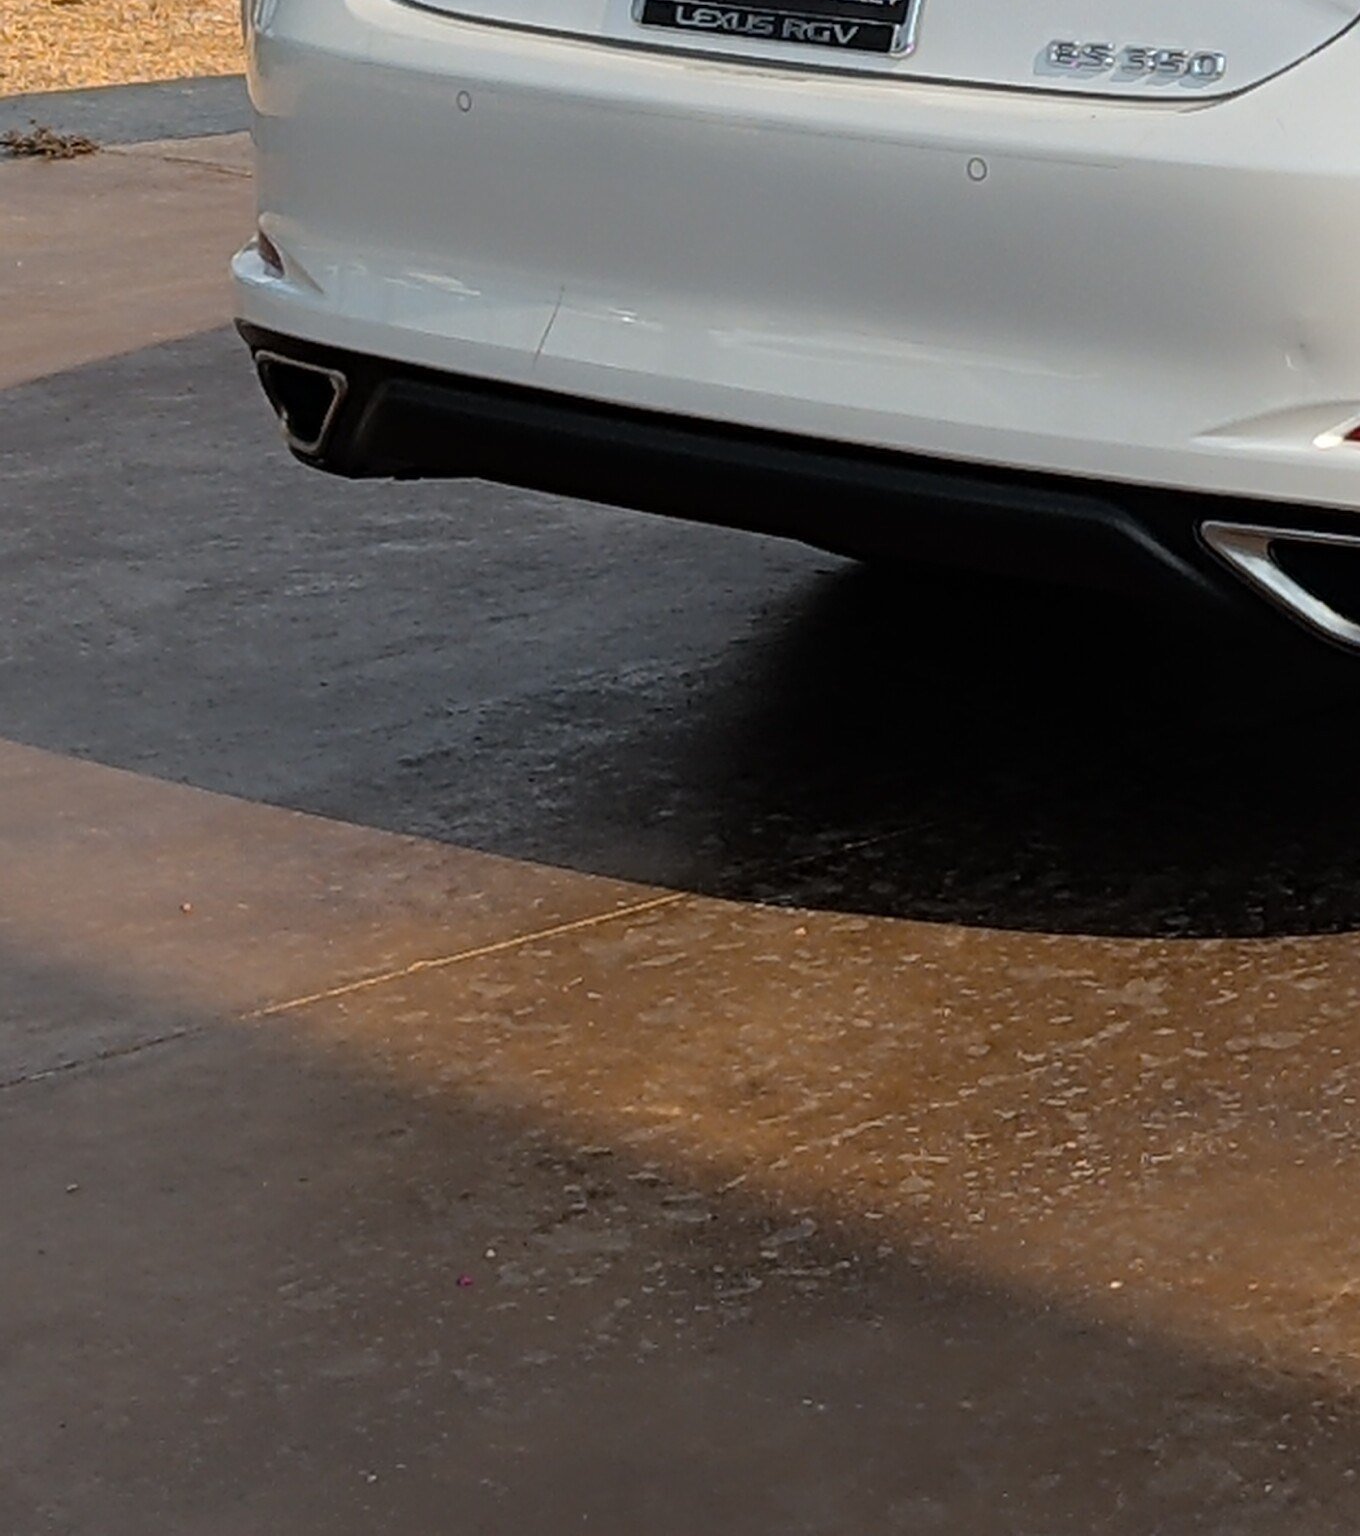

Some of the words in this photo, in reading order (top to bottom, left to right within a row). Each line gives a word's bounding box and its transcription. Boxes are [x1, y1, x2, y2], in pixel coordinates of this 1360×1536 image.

[675, 7, 774, 35] LEXUS
[782, 20, 860, 44] RGV
[1047, 40, 1116, 70] ES
[1121, 46, 1224, 81] 350
